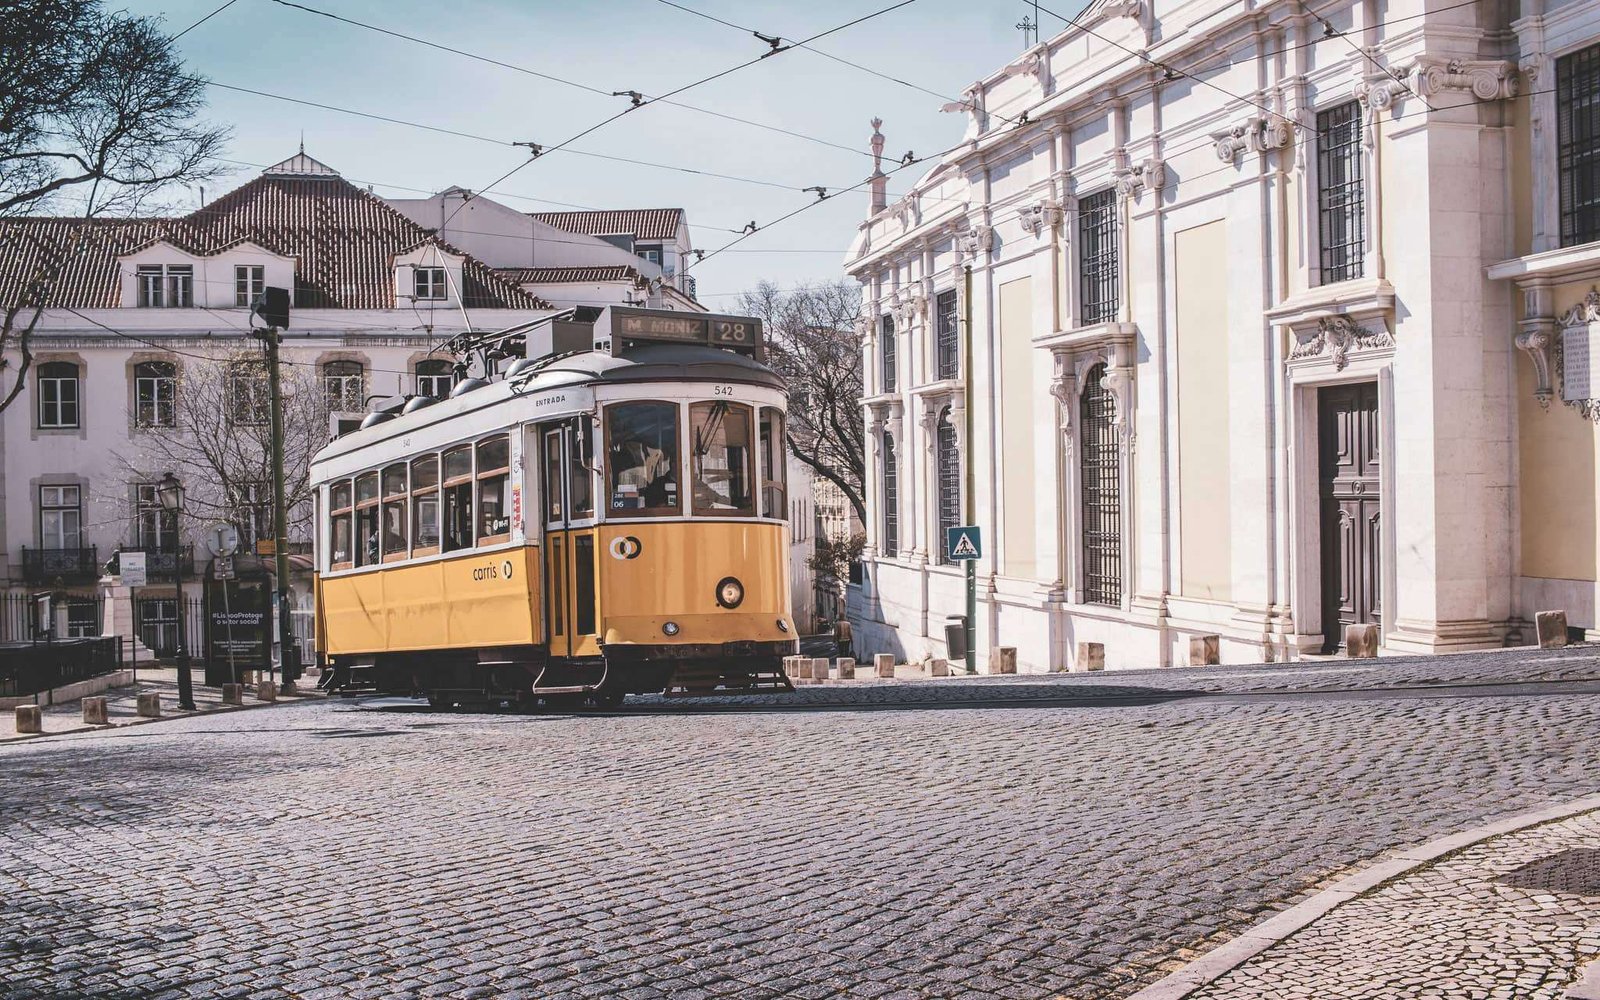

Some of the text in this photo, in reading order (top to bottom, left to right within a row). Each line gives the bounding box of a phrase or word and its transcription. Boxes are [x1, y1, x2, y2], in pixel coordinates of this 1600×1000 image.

[651, 320, 701, 334] MONIZ
[721, 322, 746, 341] 28
[714, 385, 733, 396] 542
[535, 395, 566, 407] ENTRADA
[473, 561, 498, 581] carris
[212, 612, 263, 621] #LisoaProtege
